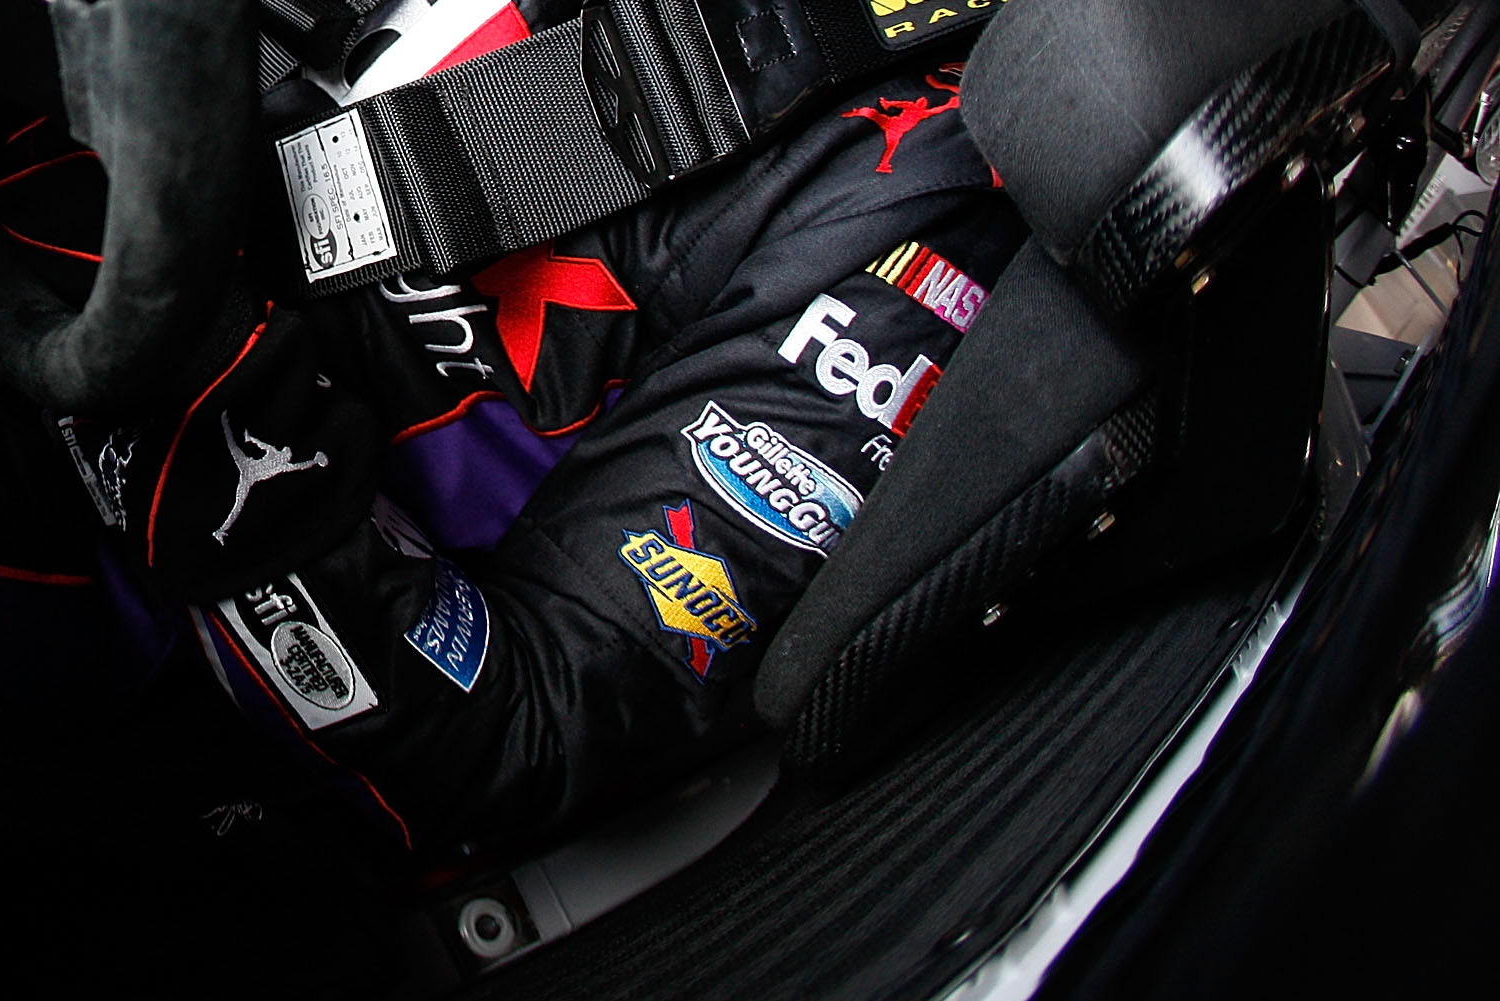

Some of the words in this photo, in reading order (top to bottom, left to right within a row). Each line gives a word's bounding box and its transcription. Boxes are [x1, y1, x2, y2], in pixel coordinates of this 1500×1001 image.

[316, 239, 334, 265] sfi
[335, 215, 344, 230] SFI
[912, 258, 988, 328] NAS
[777, 292, 942, 437] Fed
[746, 426, 818, 498] Gillette
[626, 537, 751, 645] SUNOCO
[289, 625, 350, 701] MANUFACTURER
